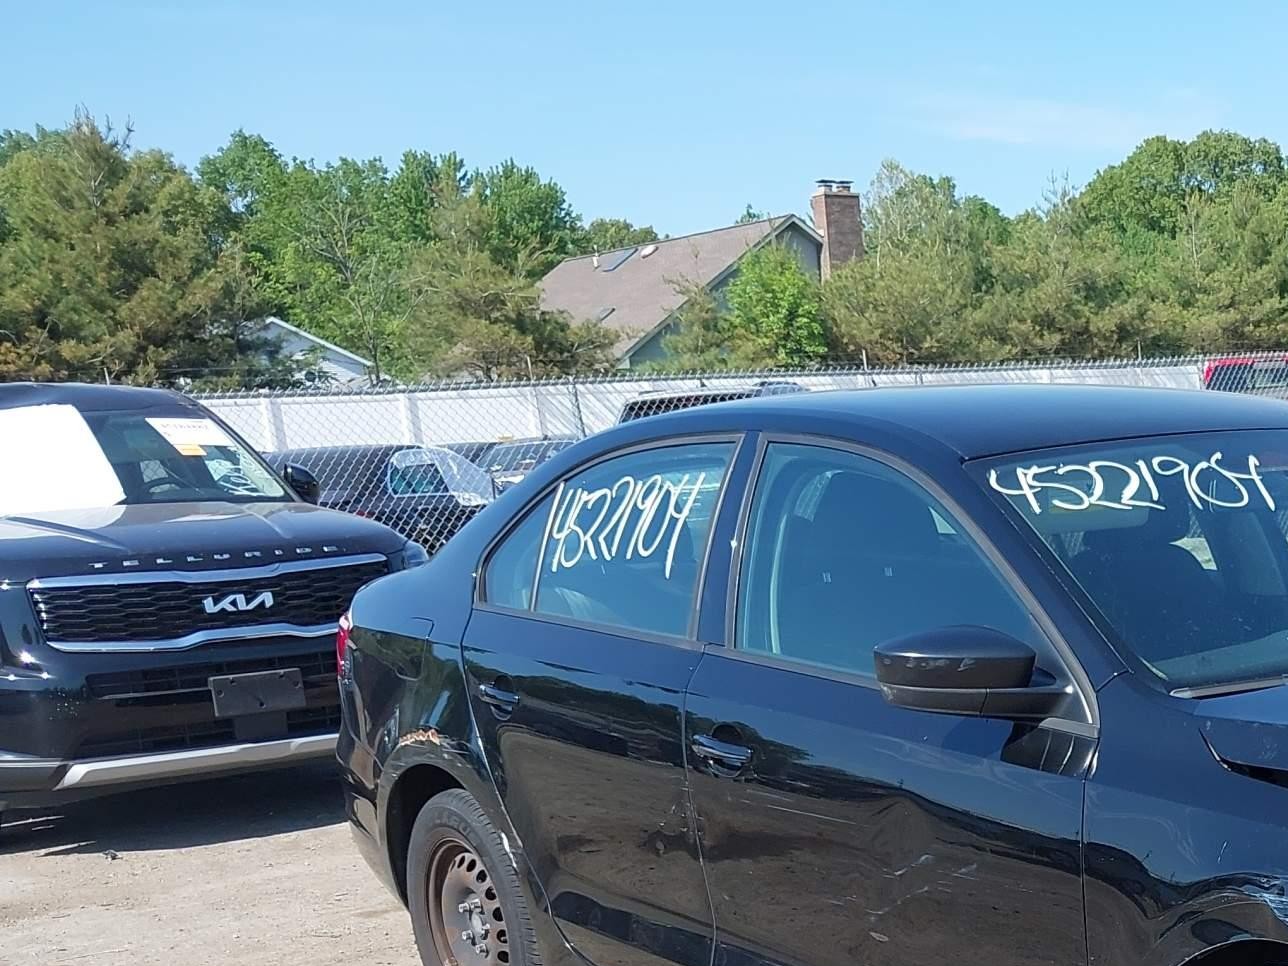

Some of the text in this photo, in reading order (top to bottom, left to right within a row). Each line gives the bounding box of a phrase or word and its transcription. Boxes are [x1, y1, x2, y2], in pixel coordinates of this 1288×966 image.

[987, 451, 1276, 515] 45221904
[88, 544, 339, 569] TELLURIDE
[202, 591, 274, 614] KIA
